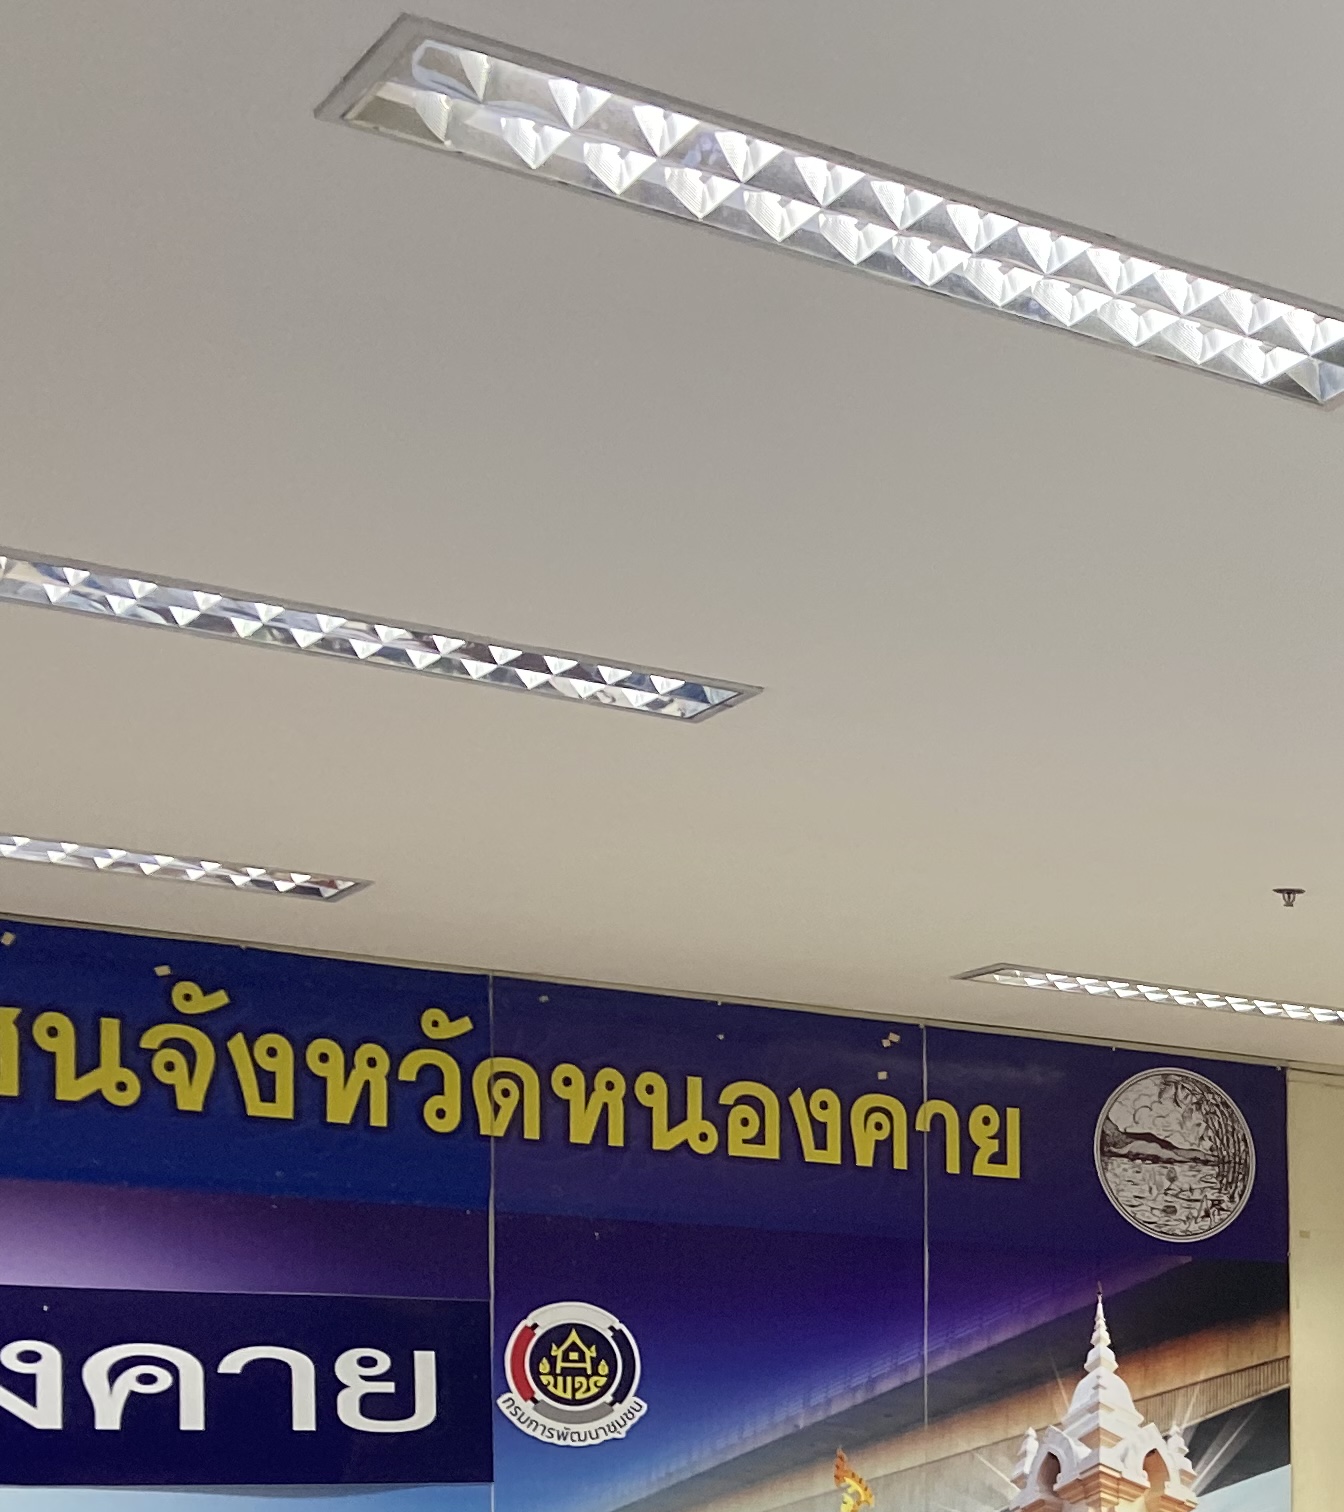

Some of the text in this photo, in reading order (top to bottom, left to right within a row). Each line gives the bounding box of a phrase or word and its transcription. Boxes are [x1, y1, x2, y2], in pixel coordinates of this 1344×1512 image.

[0, 980, 1022, 1179] นจังหวัดหนองคาย
[501, 1396, 643, 1444] กรมการพัฒนาชุมชน
